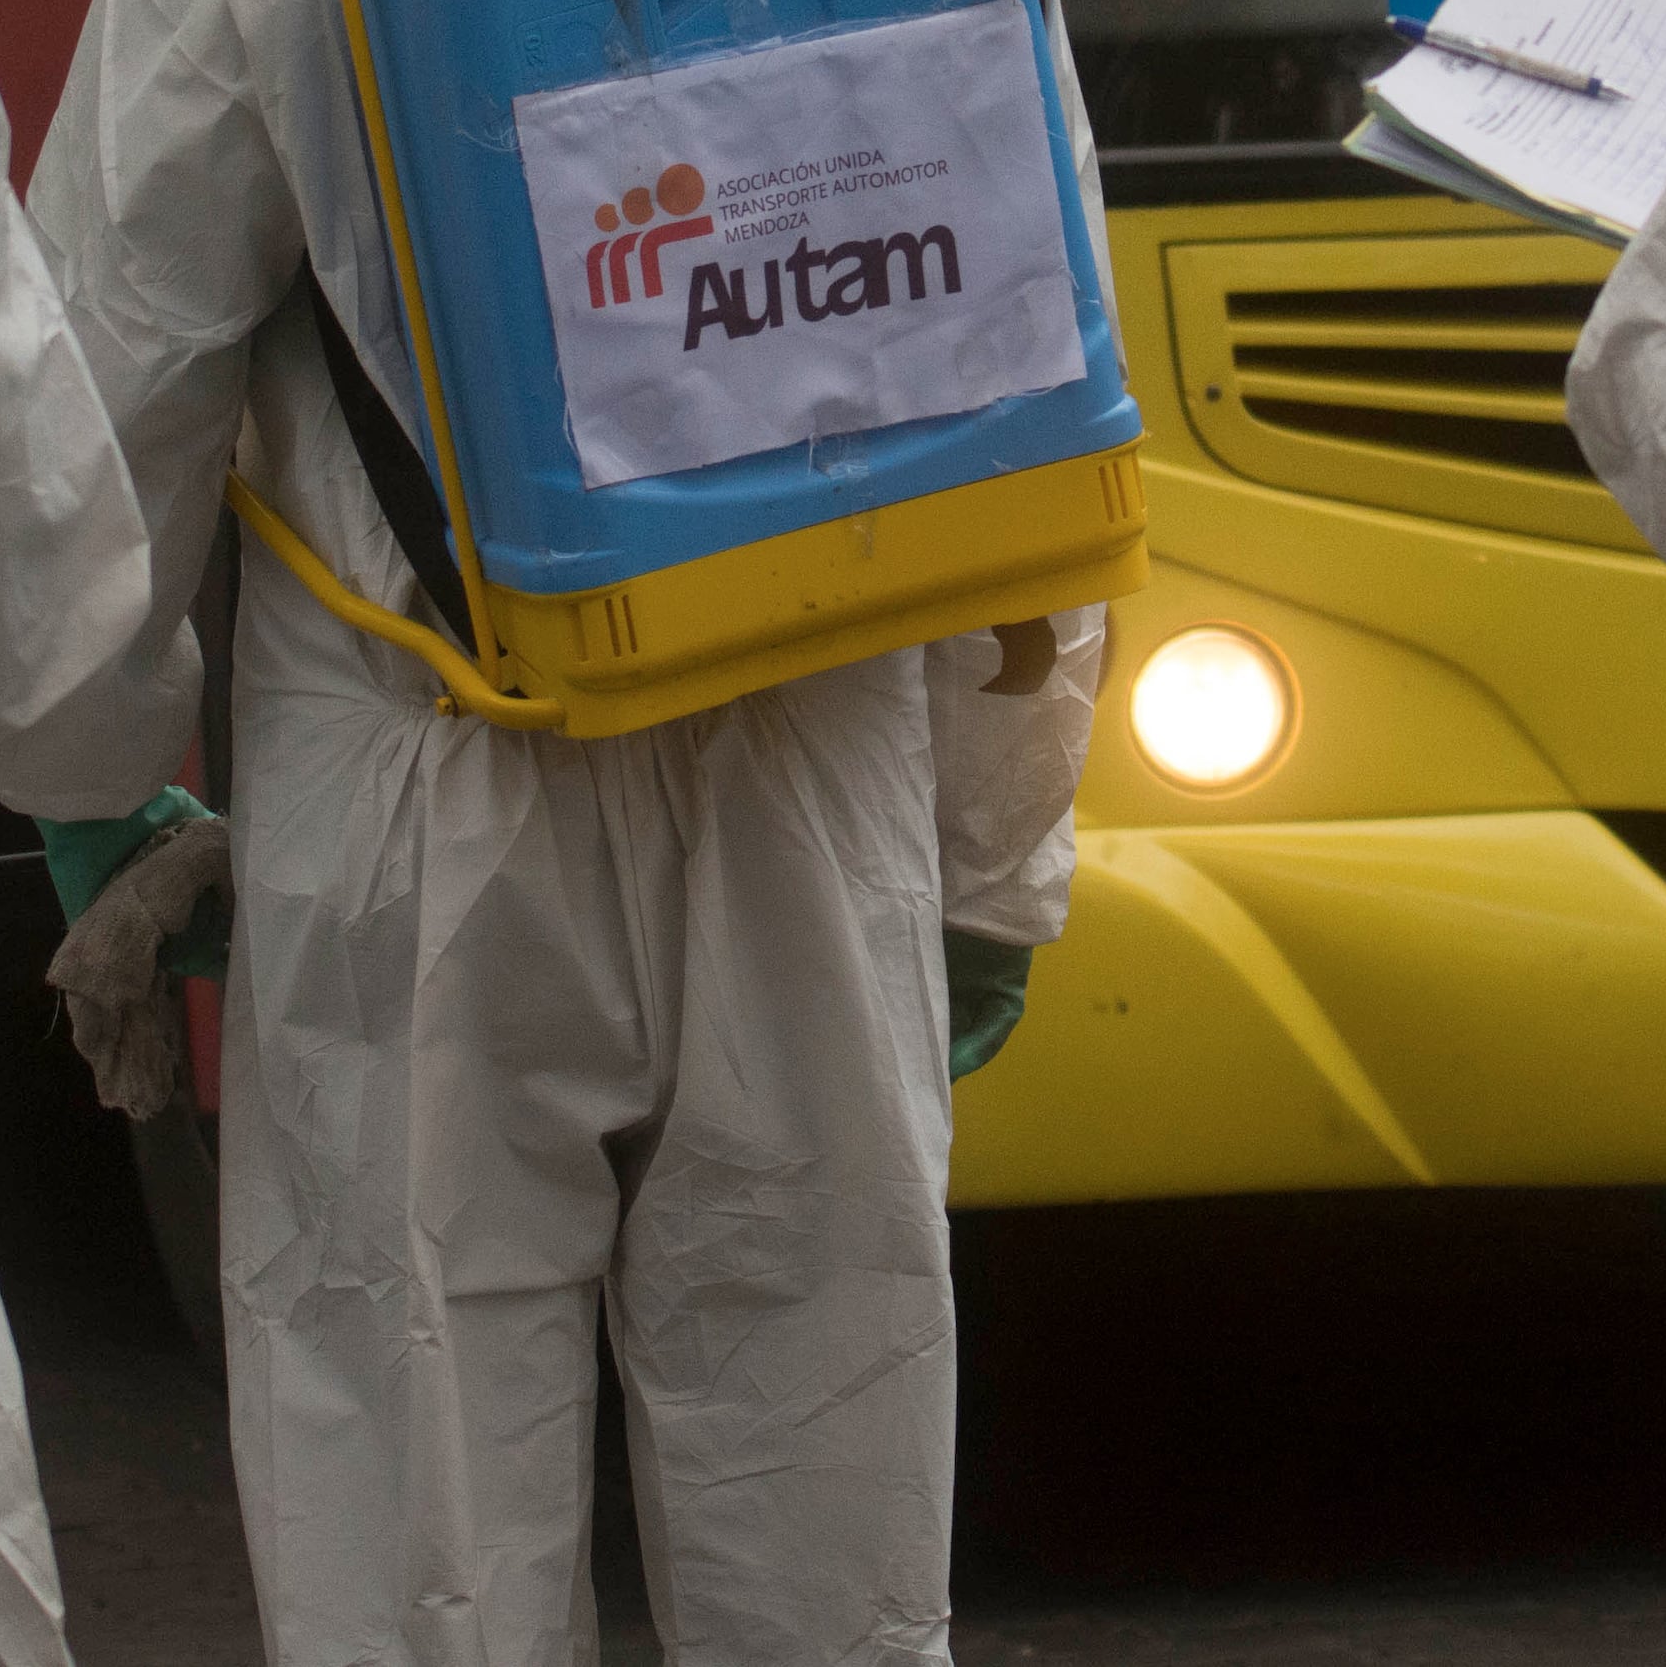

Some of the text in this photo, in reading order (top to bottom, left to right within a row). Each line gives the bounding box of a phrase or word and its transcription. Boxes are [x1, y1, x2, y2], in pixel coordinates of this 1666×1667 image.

[717, 149, 886, 199] ASOCIACIÓN UNIDA
[719, 159, 950, 221] TRANSPORTE AUTOMOTOR
[724, 211, 810, 244] MENDOZA
[683, 223, 962, 352] Autam
